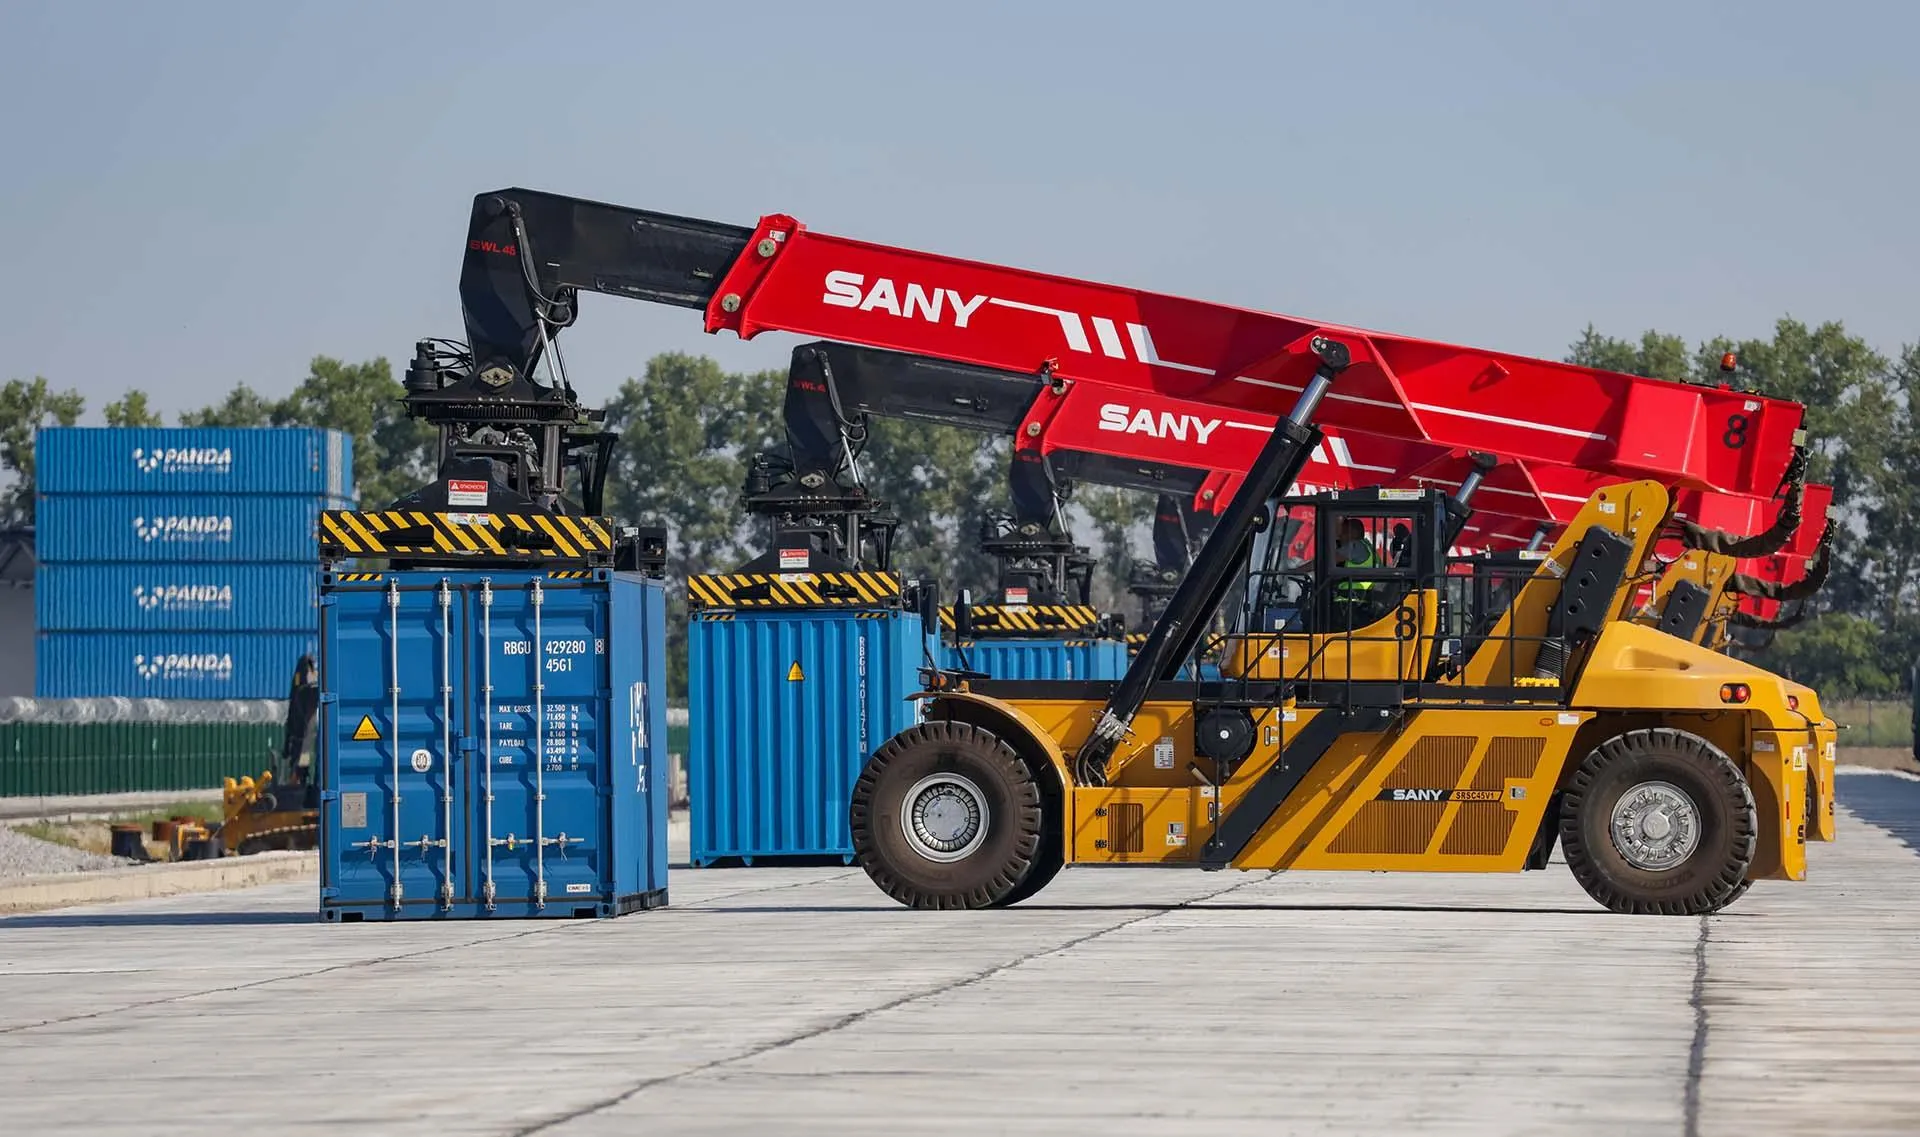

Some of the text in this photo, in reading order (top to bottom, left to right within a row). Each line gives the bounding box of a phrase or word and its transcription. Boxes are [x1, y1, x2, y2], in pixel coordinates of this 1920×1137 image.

[823, 269, 990, 328] SANY
[1098, 403, 1222, 444] SANY
[1723, 414, 1748, 449] 8
[164, 447, 233, 465] PANDA
[164, 515, 233, 533] PANDA
[164, 584, 233, 602] PANDA
[1395, 606, 1418, 640] 8
[504, 641, 531, 654] RBGU
[545, 640, 586, 654] 429280
[164, 653, 233, 671] PANDA
[546, 658, 572, 671] 45G1
[499, 739, 525, 747] PAYLOAD
[1393, 789, 1495, 801] SANY SRSC45V1
